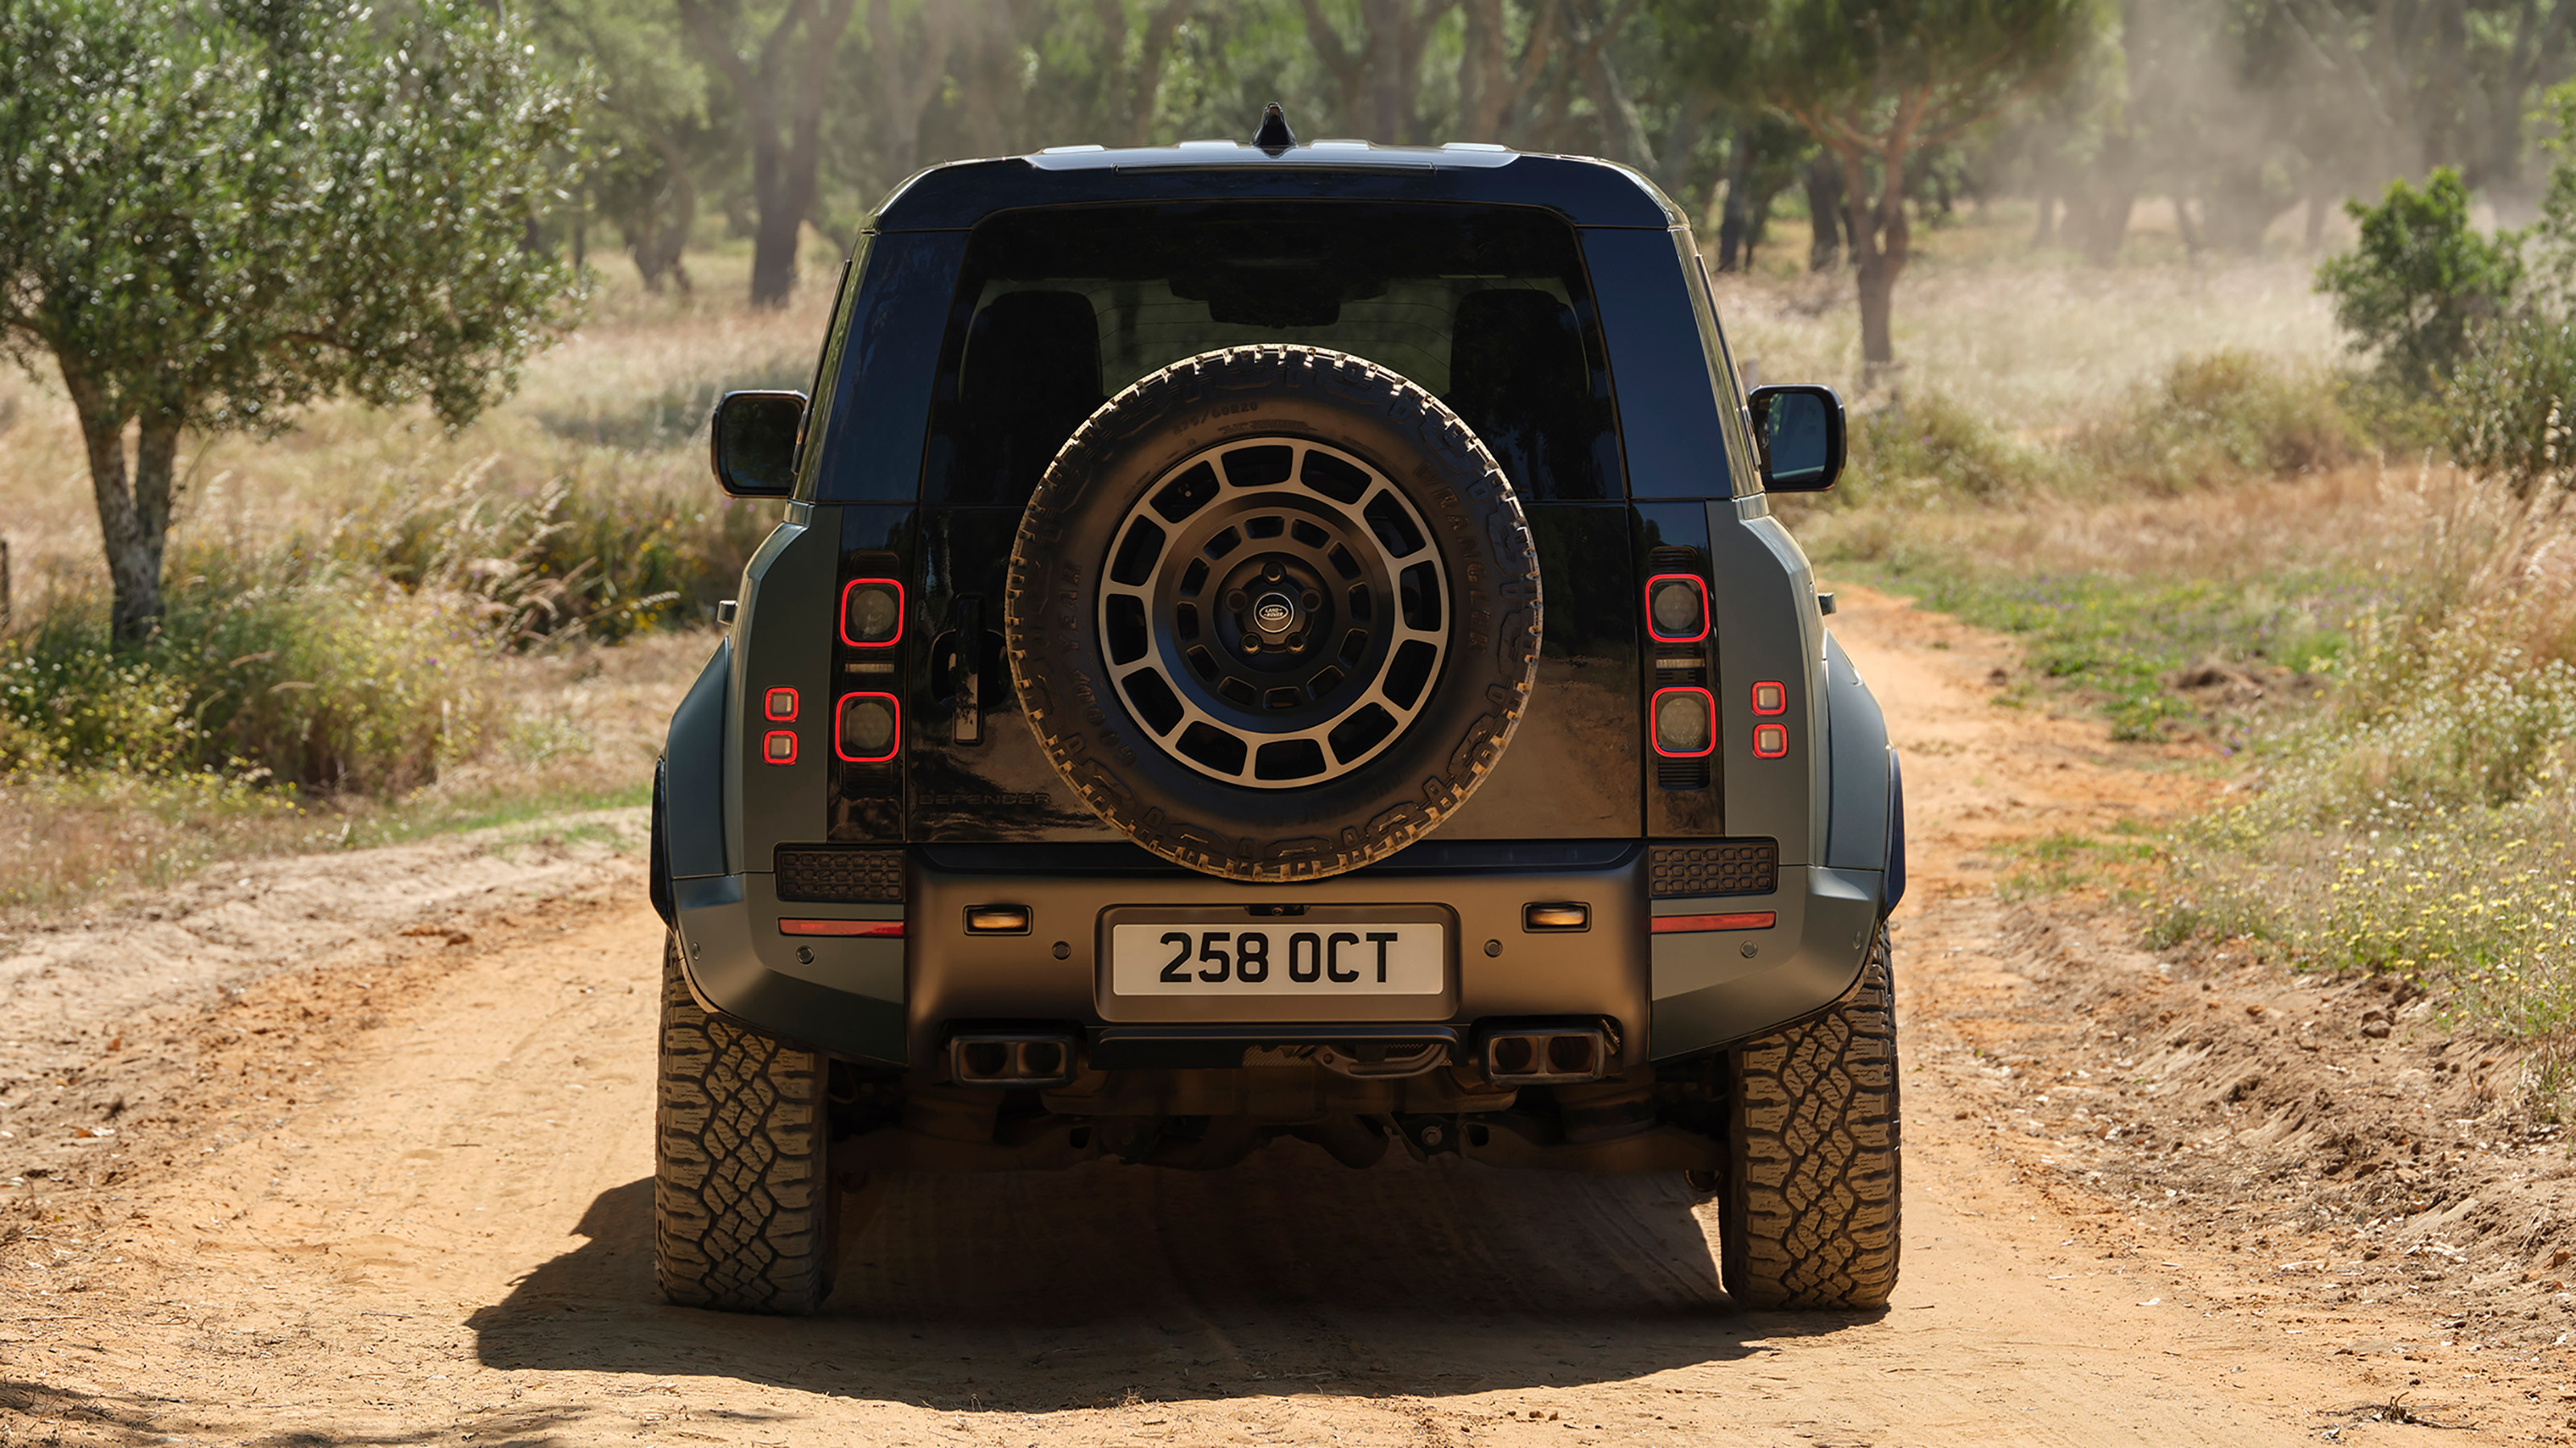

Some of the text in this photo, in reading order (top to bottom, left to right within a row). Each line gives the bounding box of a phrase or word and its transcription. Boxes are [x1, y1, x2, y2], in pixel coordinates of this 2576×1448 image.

[1413, 460, 1491, 655] WRANGLER
[919, 793, 1051, 805] DEFENDER
[1160, 932, 1397, 983] 258 OCT
